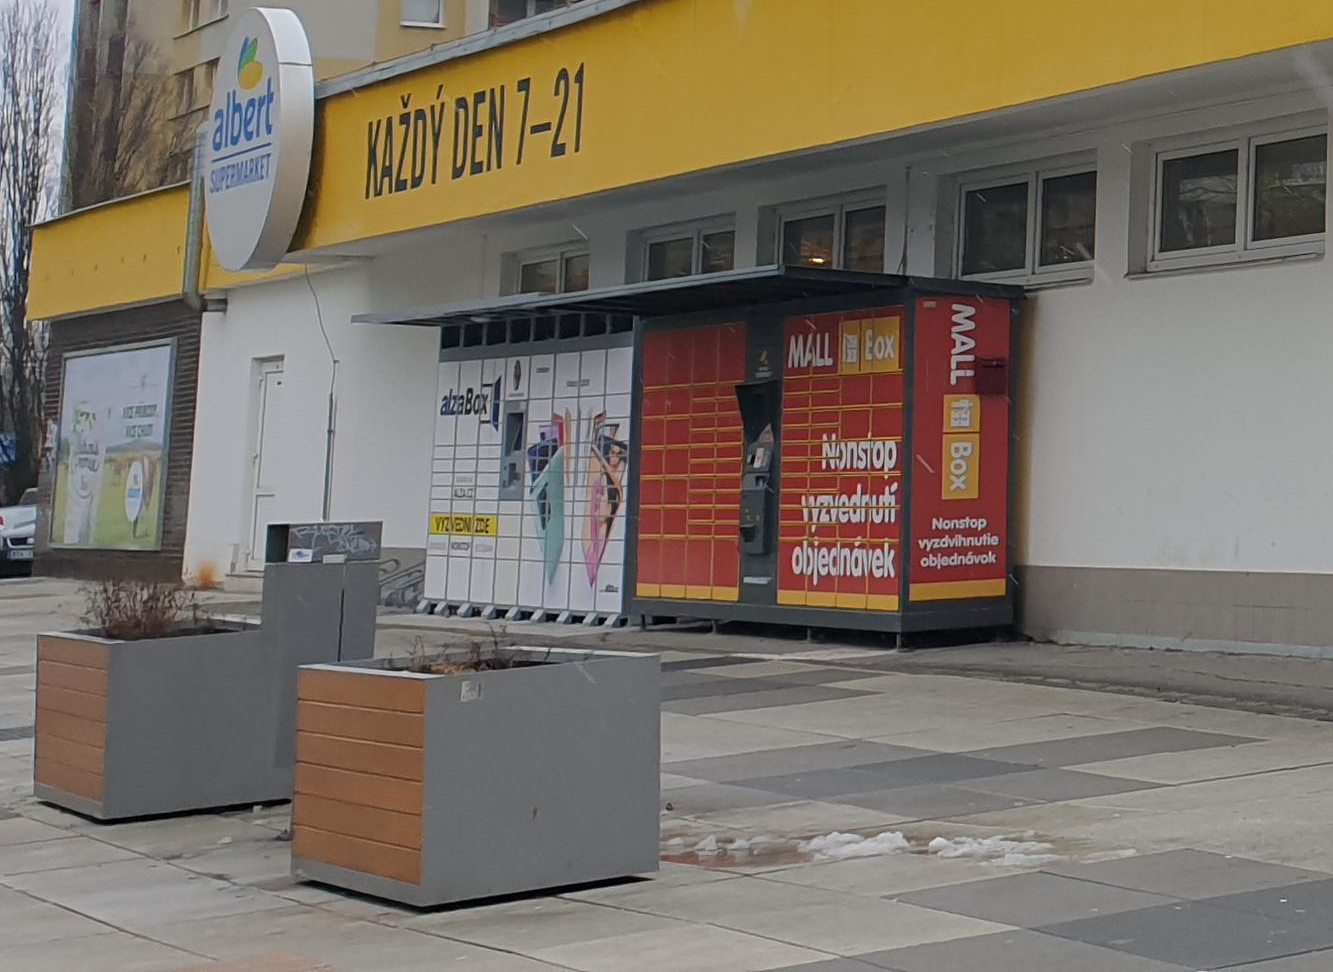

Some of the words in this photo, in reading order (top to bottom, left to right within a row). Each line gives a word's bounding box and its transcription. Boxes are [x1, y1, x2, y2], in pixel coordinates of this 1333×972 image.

[212, 77, 275, 152] albert
[365, 84, 446, 200] KAŽDÝ
[451, 84, 505, 180] DEN
[209, 153, 272, 194] SUPERMARKET
[787, 331, 834, 369] MALL
[865, 329, 896, 360] Box
[951, 303, 977, 386] MALL
[440, 387, 490, 416] alzaBox
[821, 432, 898, 479] Nonstop
[950, 441, 973, 492] Box
[474, 517, 490, 536] ZDE
[801, 481, 899, 533] vyzvednutí
[932, 516, 988, 531] Nonstop
[791, 535, 896, 586] objednávek
[920, 551, 998, 570] objednávok
